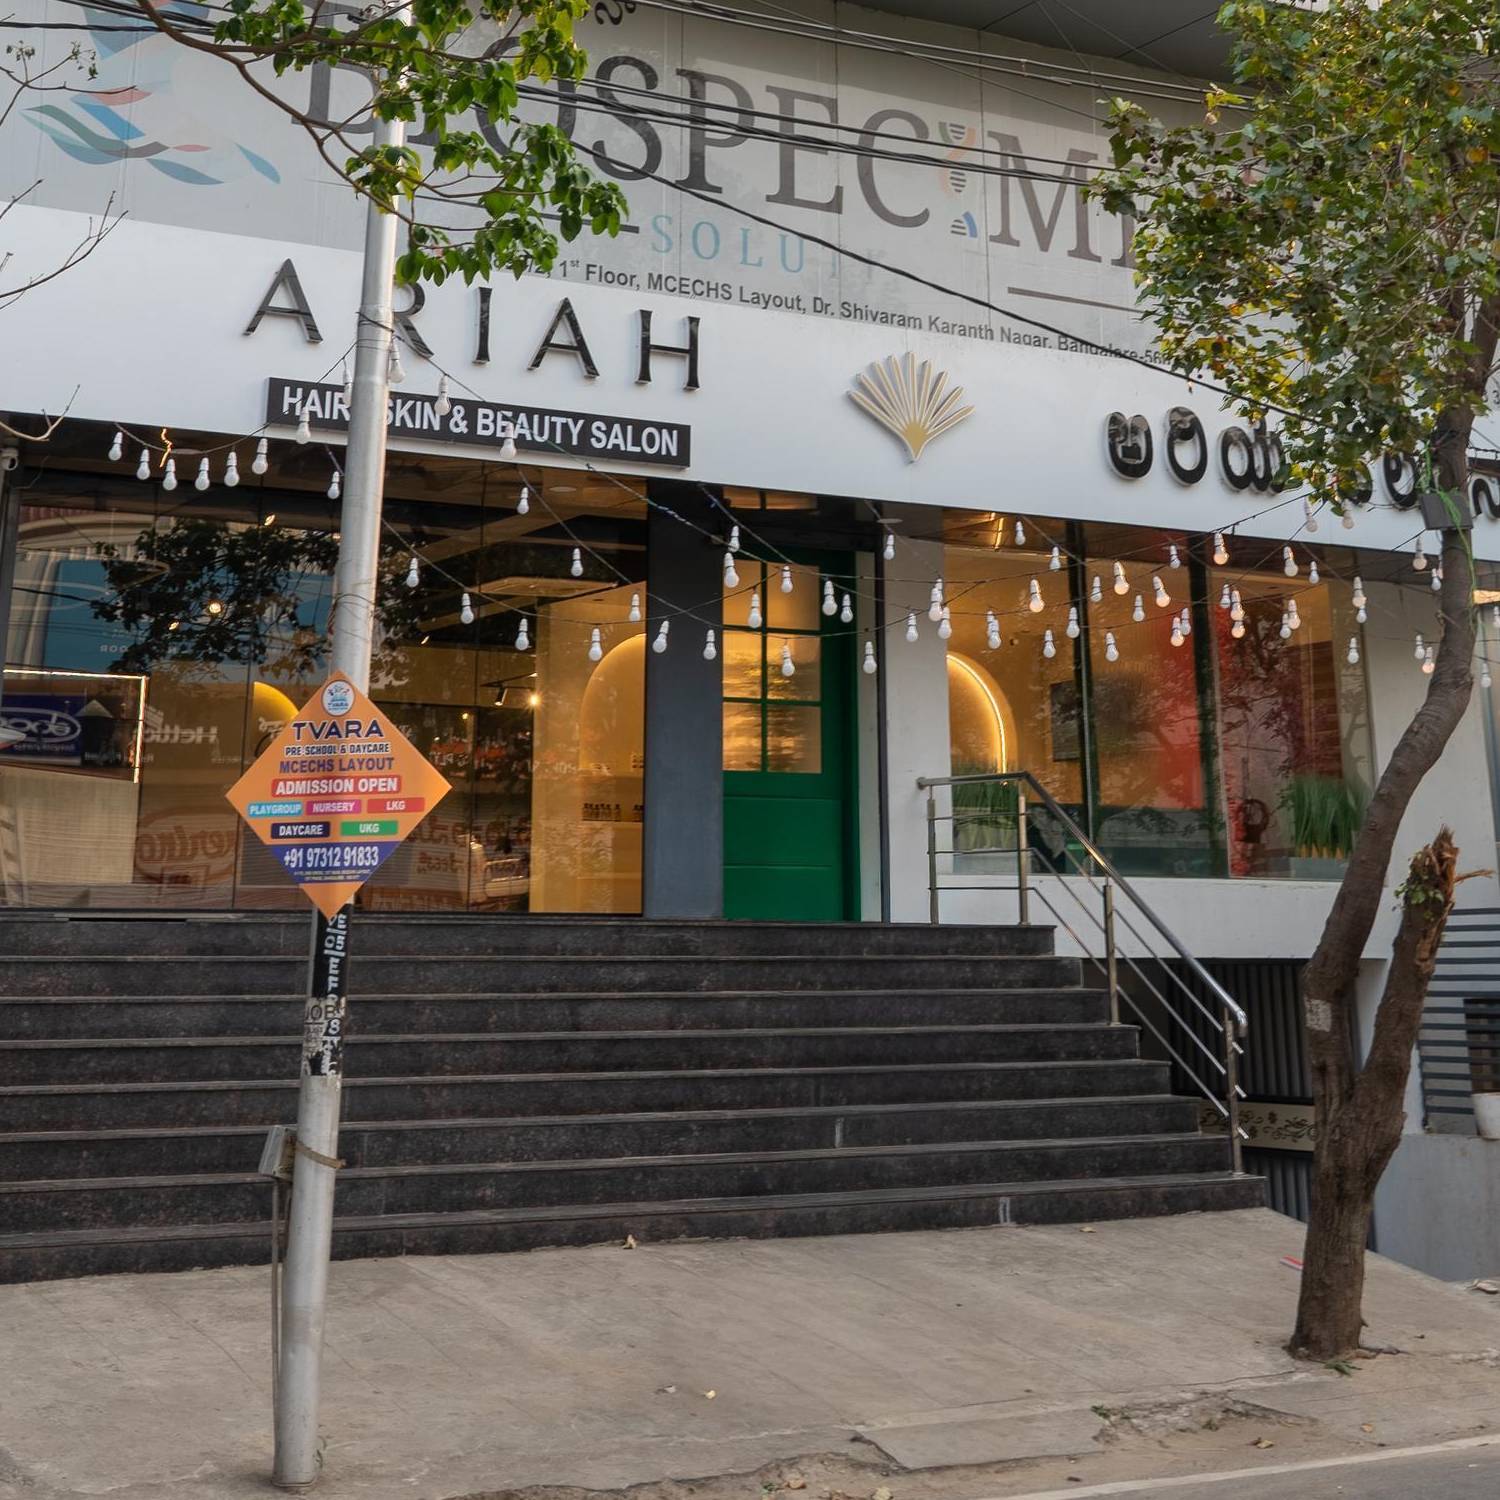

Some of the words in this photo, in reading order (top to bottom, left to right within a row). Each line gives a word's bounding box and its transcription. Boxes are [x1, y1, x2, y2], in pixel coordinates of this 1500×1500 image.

[585, 263, 641, 292] Floor,
[647, 272, 733, 301] MCECHS
[739, 284, 807, 315] Layout,
[812, 296, 836, 317] Dr.
[840, 301, 923, 331] Shivaram
[928, 314, 995, 341] Karanth
[243, 258, 701, 392] ARIAH
[384, 398, 442, 431] SKIN
[448, 405, 469, 435] &
[476, 407, 585, 445] BEAUTY
[590, 424, 679, 458] SALON
[292, 719, 384, 740] TVARA
[285, 744, 338, 756] PRE-SCHOOL
[349, 743, 390, 754] DAYCARE
[279, 758, 334, 774] MCECHS
[338, 757, 394, 772] LAYOUT
[275, 778, 354, 795] ADMISSION
[358, 777, 398, 792] OPEN
[249, 803, 302, 815] PLAYGROUP
[312, 801, 356, 813] NURSERY
[386, 800, 406, 811] LKG
[278, 824, 324, 836] DAYCARE
[359, 823, 380, 834] UKG
[283, 849, 304, 867] +91
[306, 847, 341, 867] 97312
